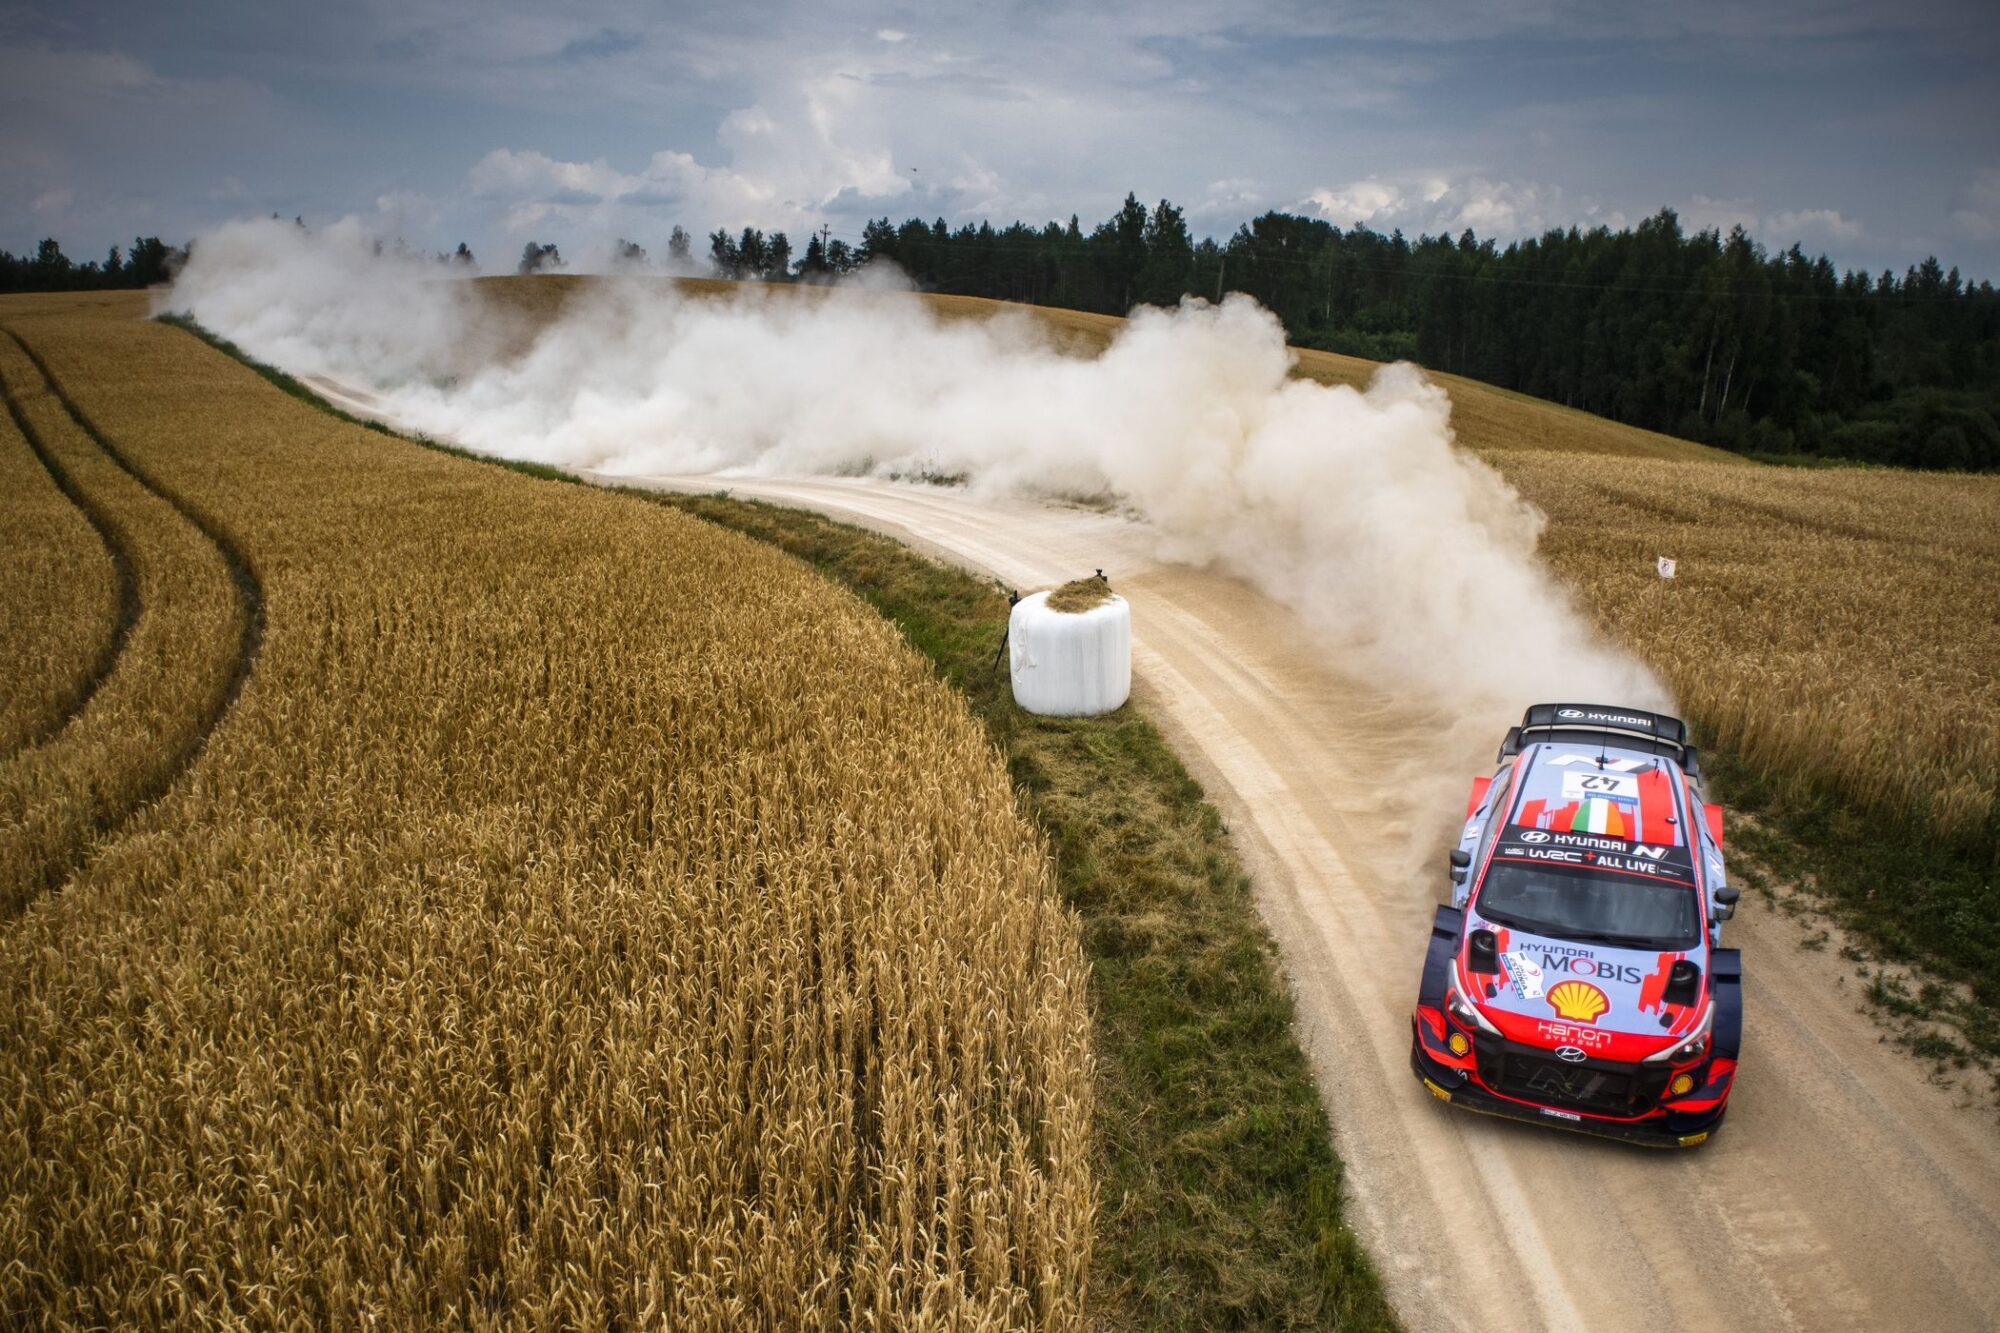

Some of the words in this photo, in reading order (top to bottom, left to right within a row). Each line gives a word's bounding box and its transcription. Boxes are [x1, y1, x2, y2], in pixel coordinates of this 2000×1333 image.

[1588, 713, 1652, 727] HYUNDAI
[1581, 775, 1621, 791] 42
[1554, 834, 1627, 852] HYUNDAI
[1632, 845, 1666, 860] N
[1597, 855, 1624, 869] ALL
[1626, 859, 1657, 874] LIVE
[1520, 943, 1594, 959] HYUNDAI
[1542, 954, 1642, 985] MOBIS
[1545, 1034, 1602, 1049] SYSTEMS
